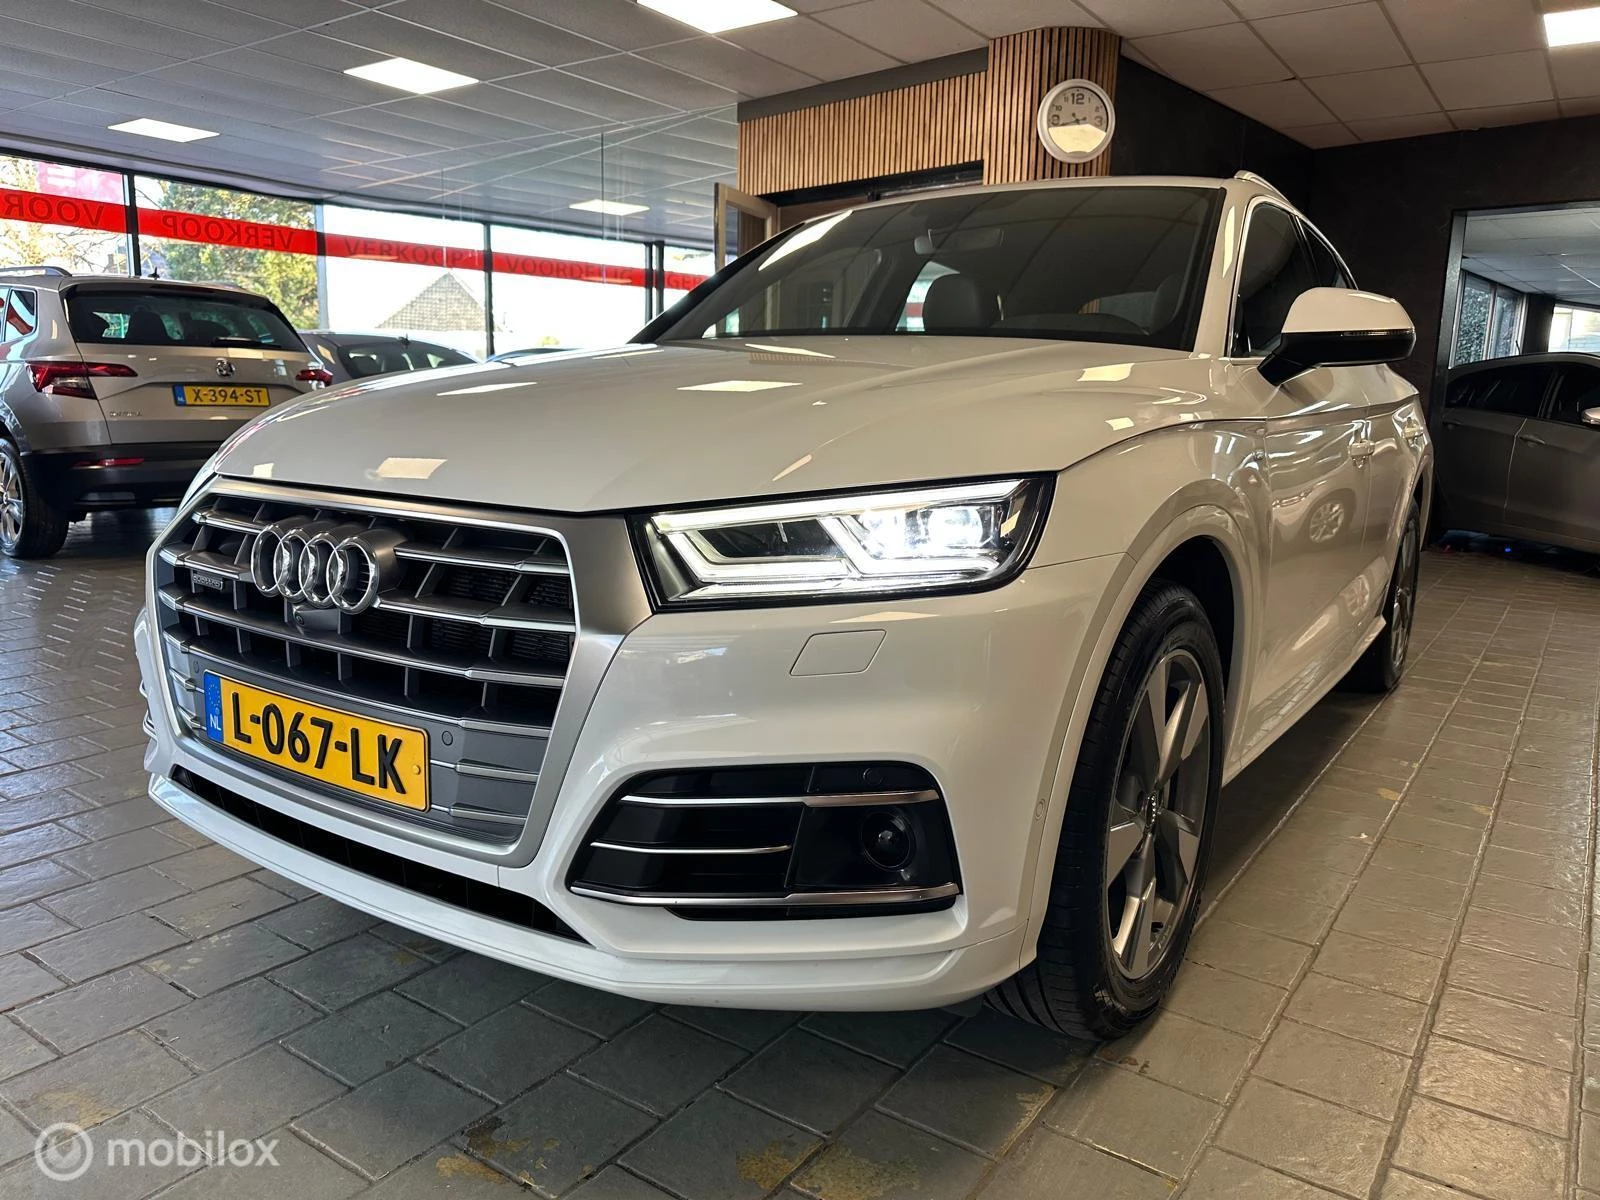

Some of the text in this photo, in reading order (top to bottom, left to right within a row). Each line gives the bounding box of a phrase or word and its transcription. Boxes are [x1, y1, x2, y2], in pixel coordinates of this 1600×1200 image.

[1070, 92, 1085, 105] 12
[1094, 115, 1104, 127] 3
[343, 237, 464, 265] VERKOOP
[192, 388, 262, 403] X-394-ST
[209, 713, 222, 731] NL
[232, 692, 407, 794] L-067-LK
